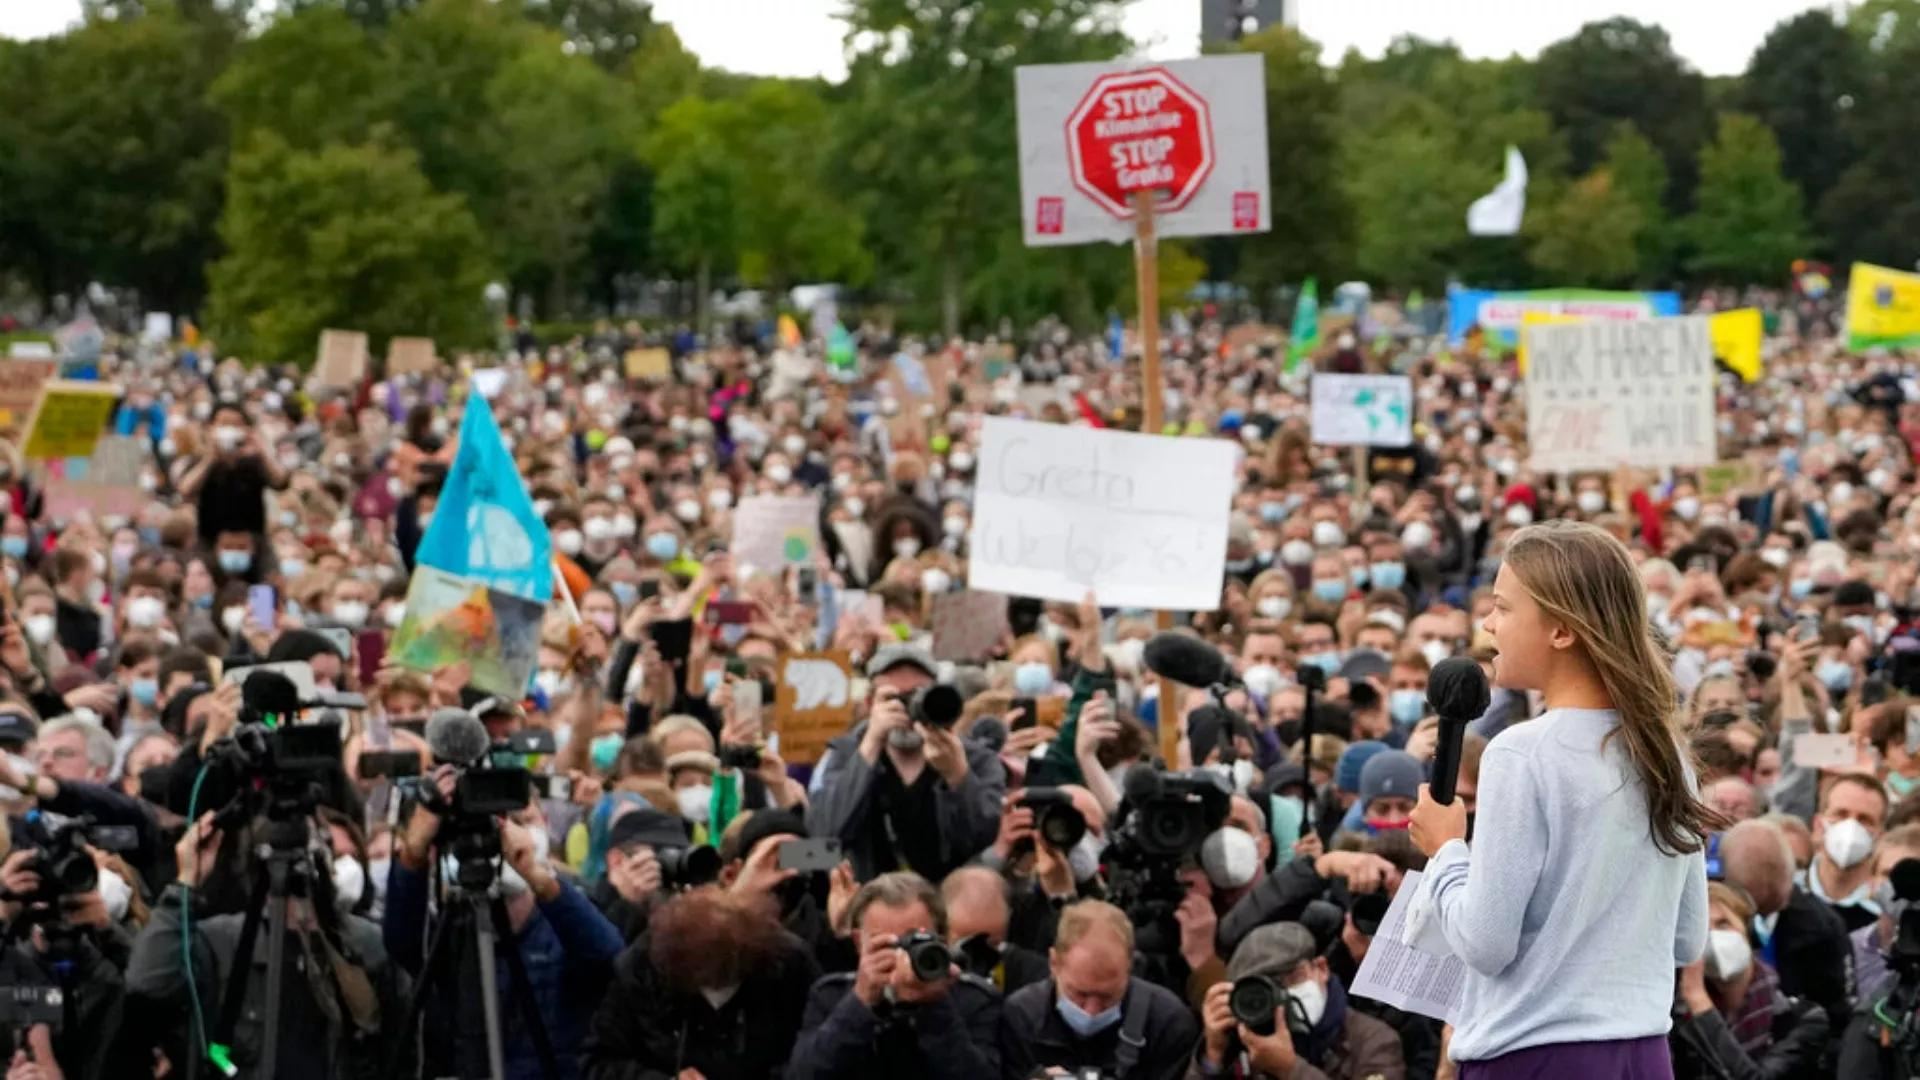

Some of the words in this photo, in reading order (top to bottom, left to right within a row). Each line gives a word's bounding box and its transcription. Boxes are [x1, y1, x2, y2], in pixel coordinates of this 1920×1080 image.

[1103, 85, 1168, 118] STOP
[1109, 136, 1175, 169] STOP
[1530, 326, 1584, 383] WIR
[1590, 321, 1704, 380] HABEN
[998, 436, 1135, 501] Greta
